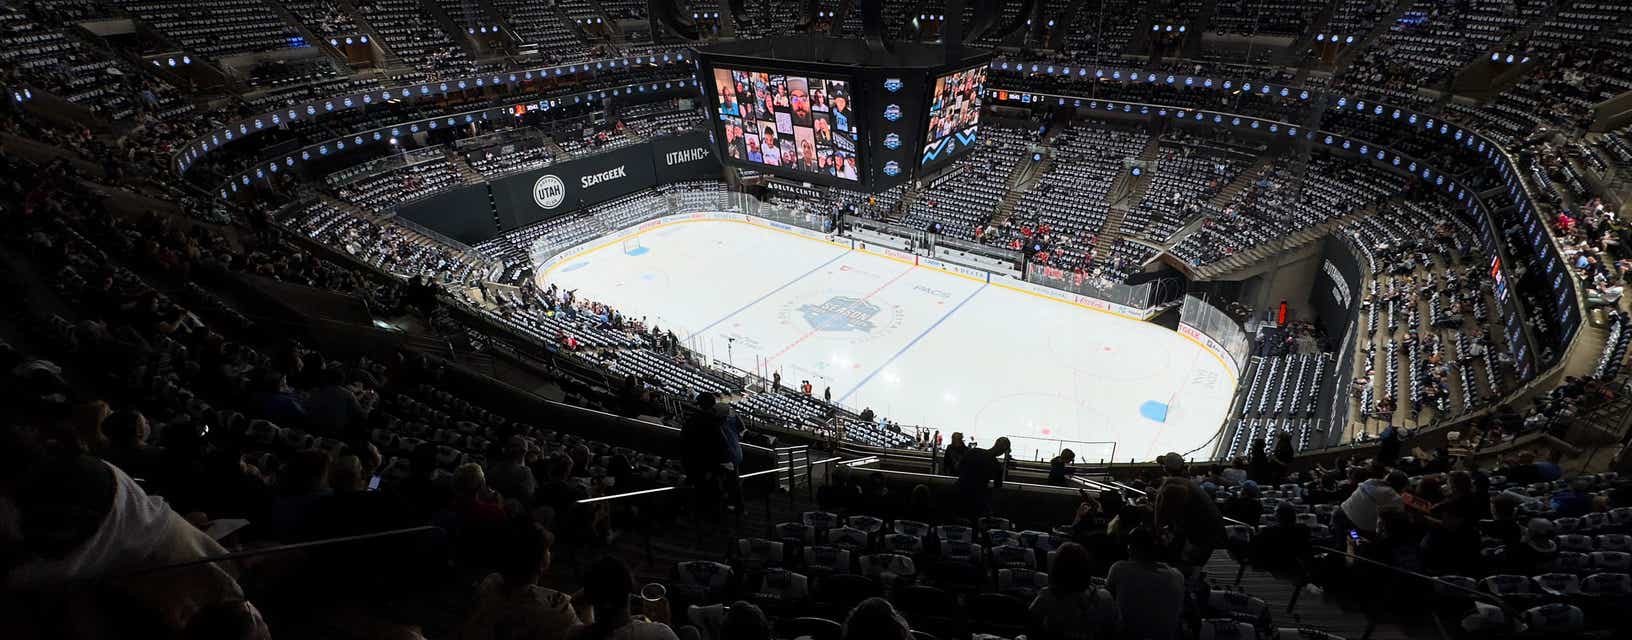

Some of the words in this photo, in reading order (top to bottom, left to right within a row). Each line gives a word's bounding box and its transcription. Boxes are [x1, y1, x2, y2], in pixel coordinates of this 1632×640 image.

[666, 150, 690, 165] UTAH
[690, 147, 709, 161] HC+
[581, 165, 627, 188] SEATGEEK
[538, 184, 561, 200] UTAH
[773, 183, 795, 193] DELTA
[795, 187, 821, 198] CENTER
